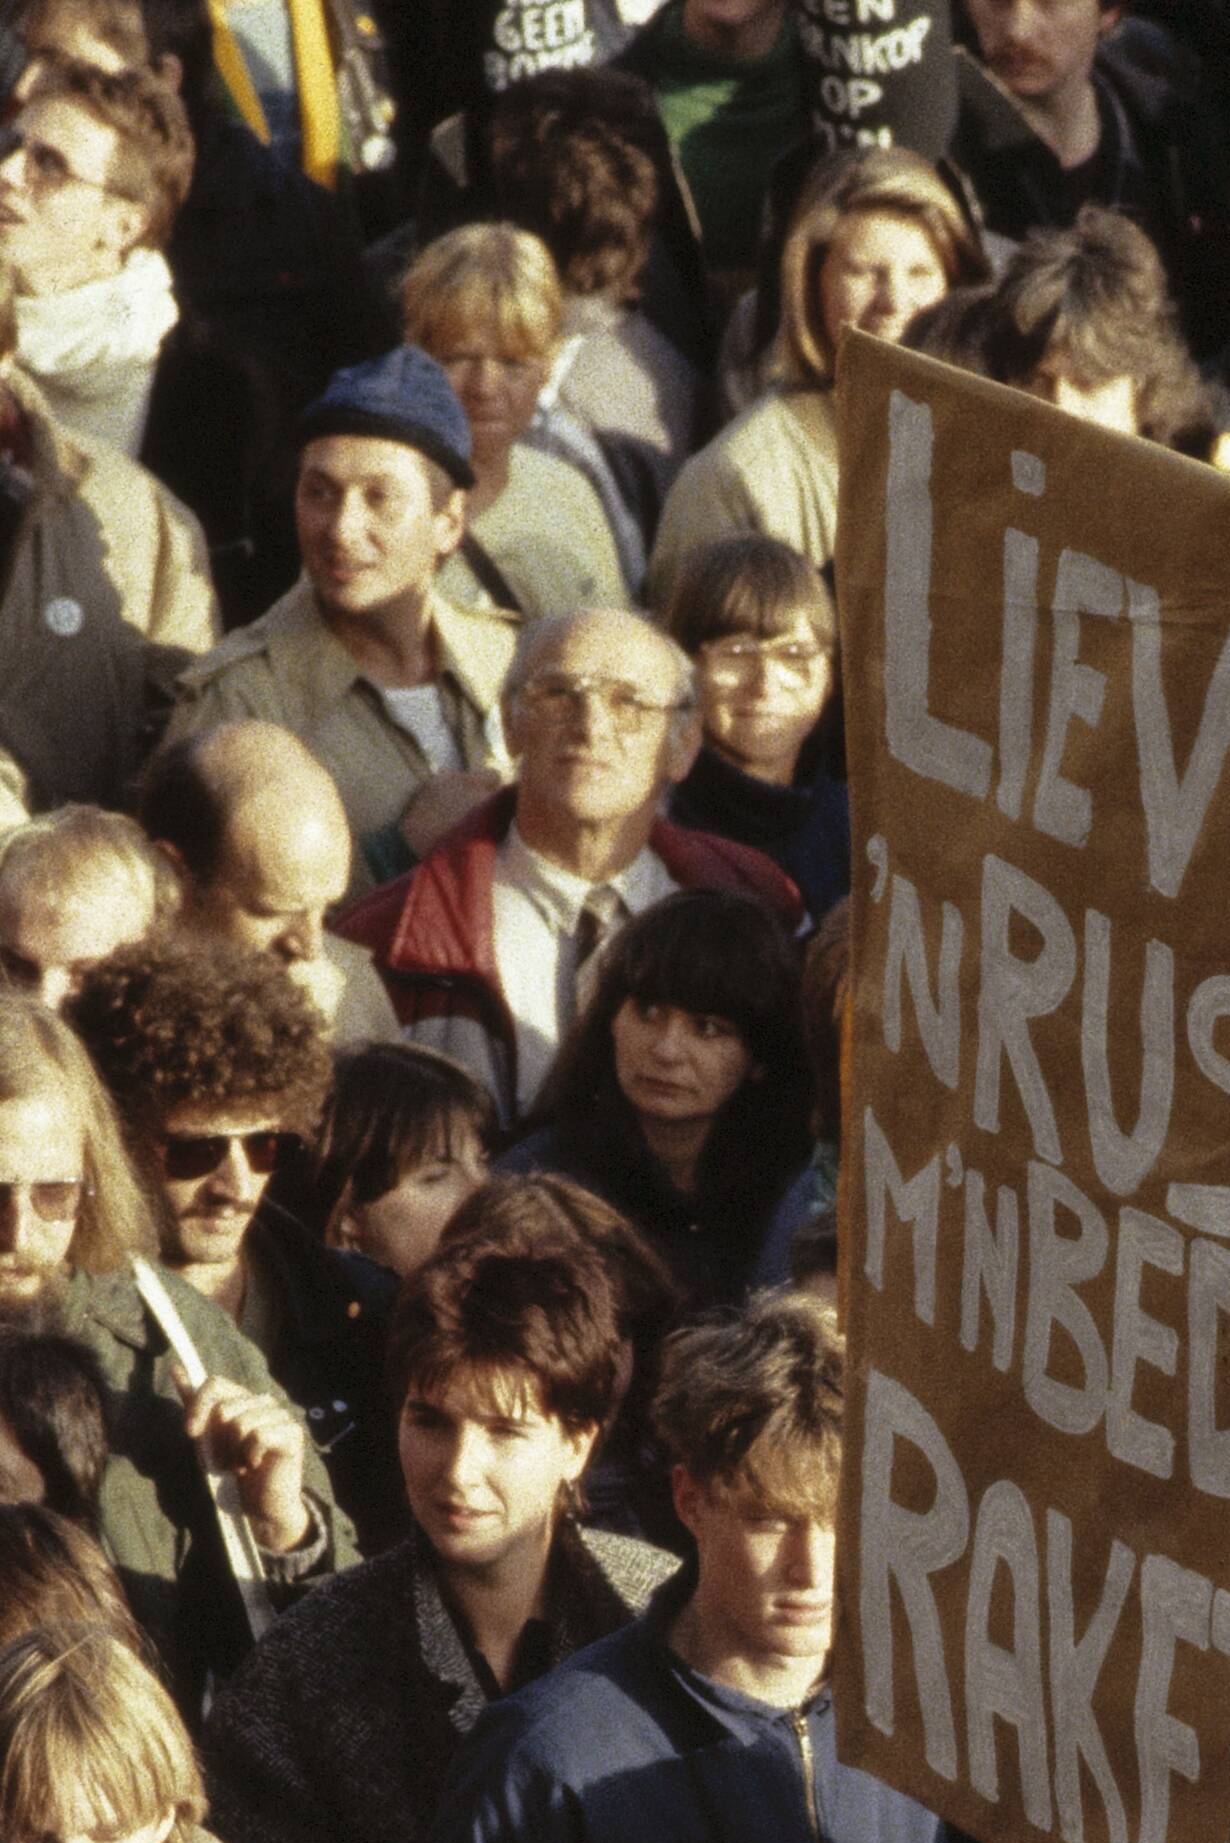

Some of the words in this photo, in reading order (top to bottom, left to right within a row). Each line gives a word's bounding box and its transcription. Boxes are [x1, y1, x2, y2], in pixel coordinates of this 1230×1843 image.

[820, 75, 884, 119] OP
[864, 834, 966, 1091] 'N
[862, 1105, 1018, 1371] M'N
